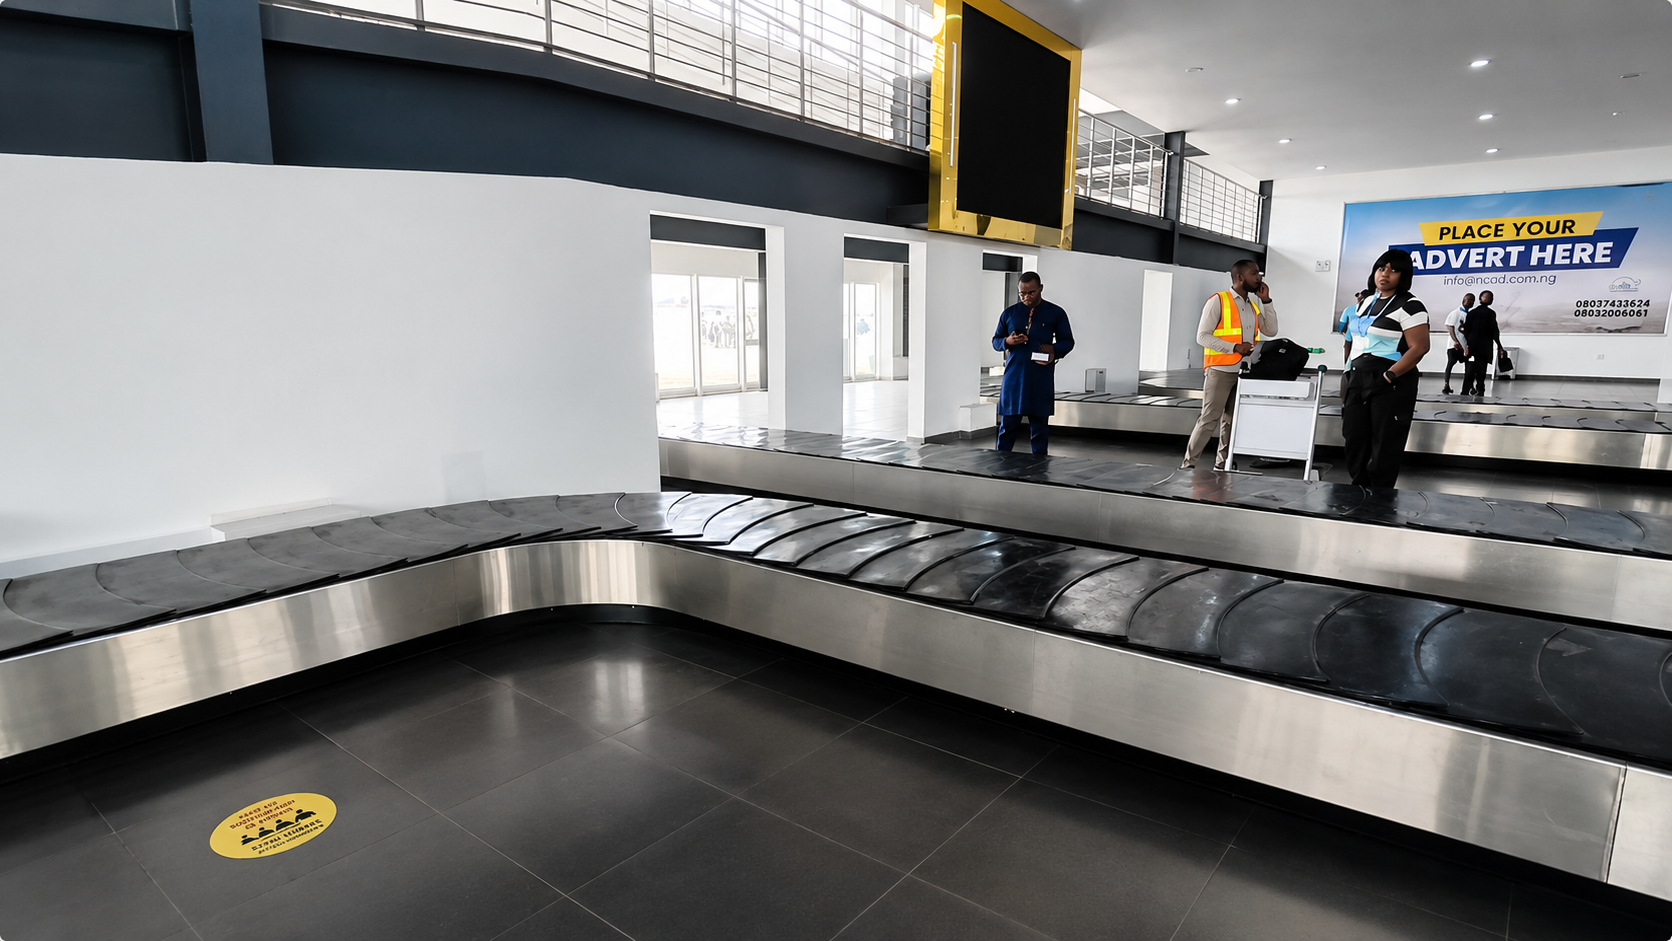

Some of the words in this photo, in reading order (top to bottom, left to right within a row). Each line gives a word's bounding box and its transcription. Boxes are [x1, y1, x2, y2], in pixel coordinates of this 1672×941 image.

[1439, 223, 1505, 240] PLACE
[1512, 219, 1576, 237] YOUR
[1410, 245, 1525, 270] ADVERT
[1529, 241, 1614, 266] HERE
[1575, 299, 1650, 308] 08037433624
[1574, 309, 1648, 317] 08032006061
